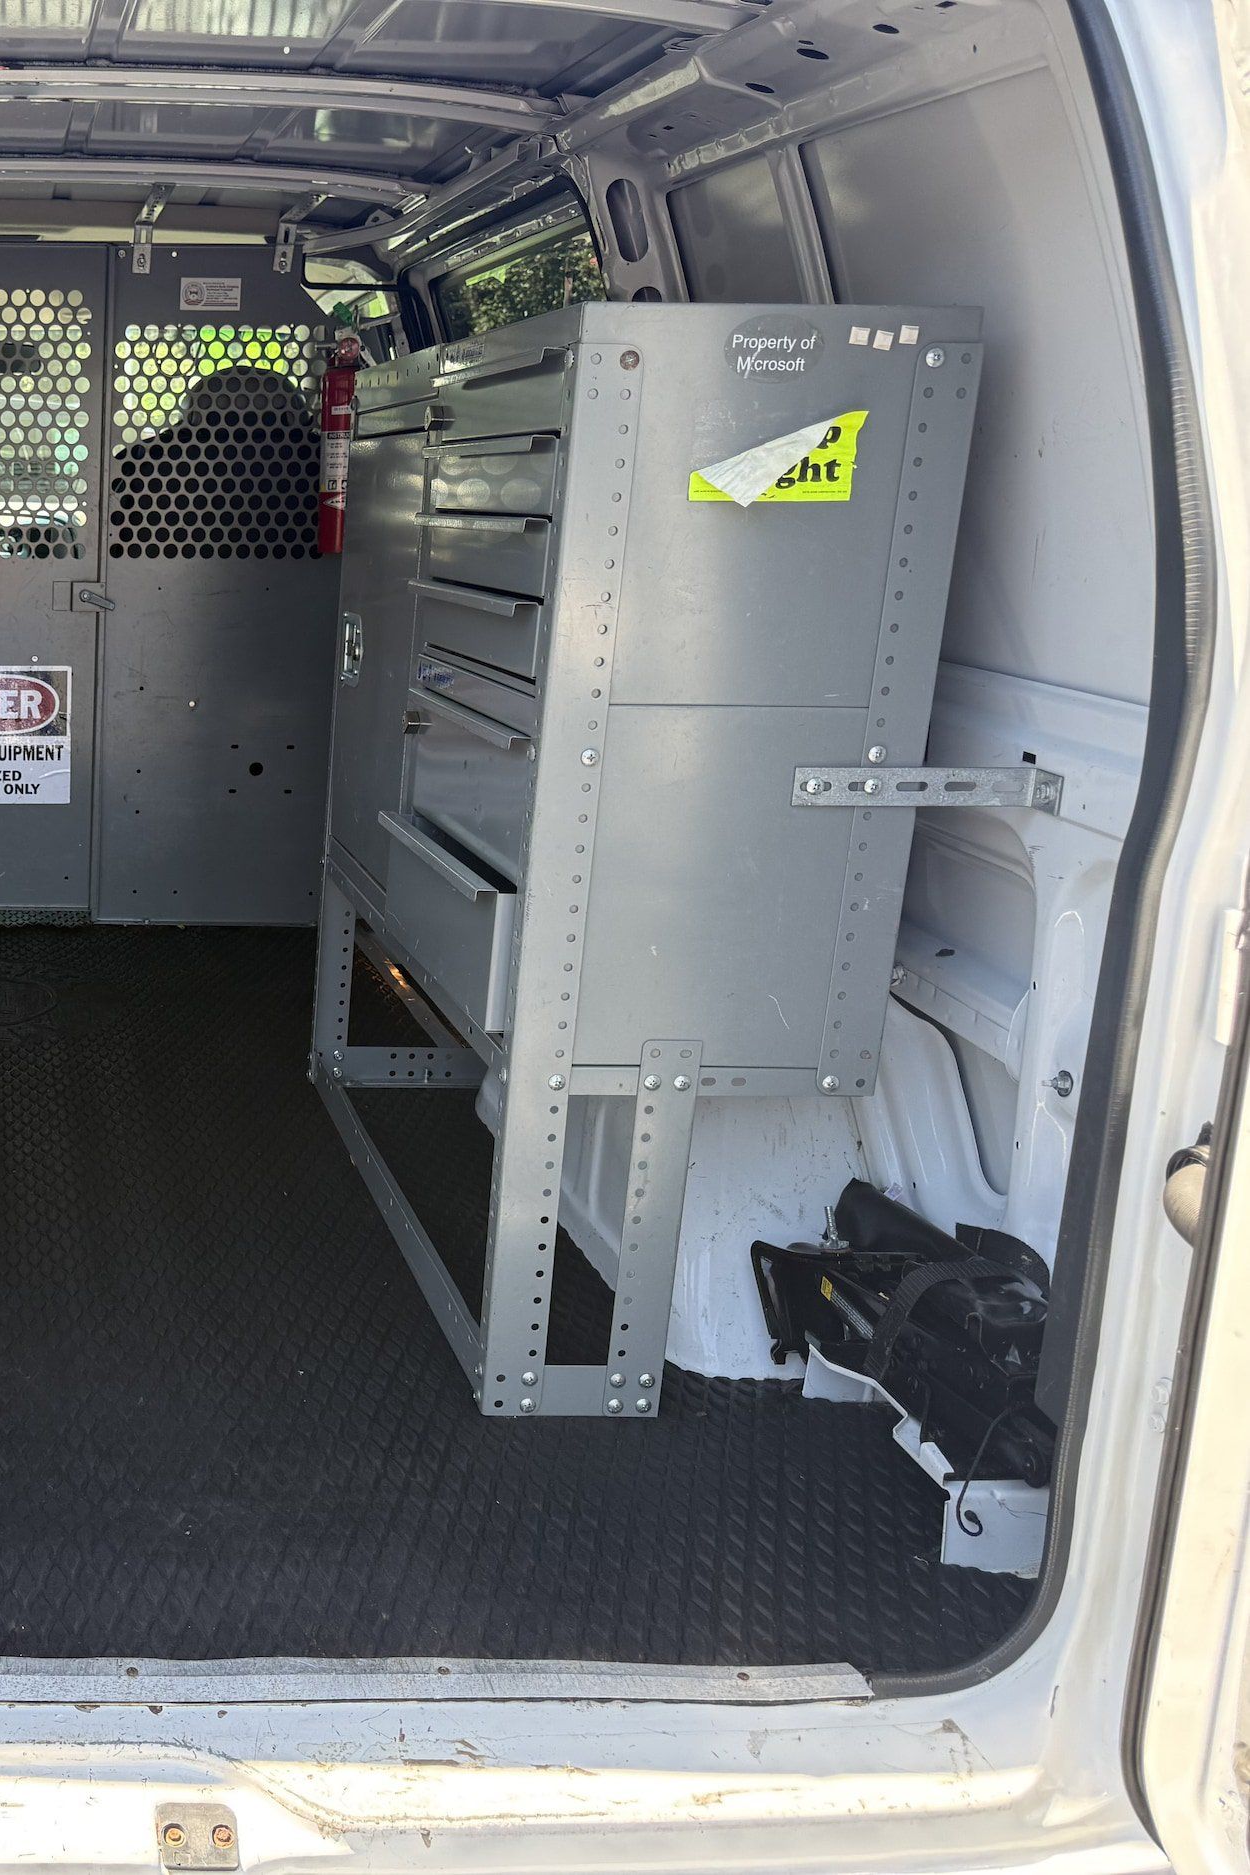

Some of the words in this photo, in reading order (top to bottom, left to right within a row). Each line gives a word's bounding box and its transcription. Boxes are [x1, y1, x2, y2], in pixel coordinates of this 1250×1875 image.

[732, 334, 797, 352] Property
[800, 335, 816, 350] of
[4, 783, 41, 795] ONLY
